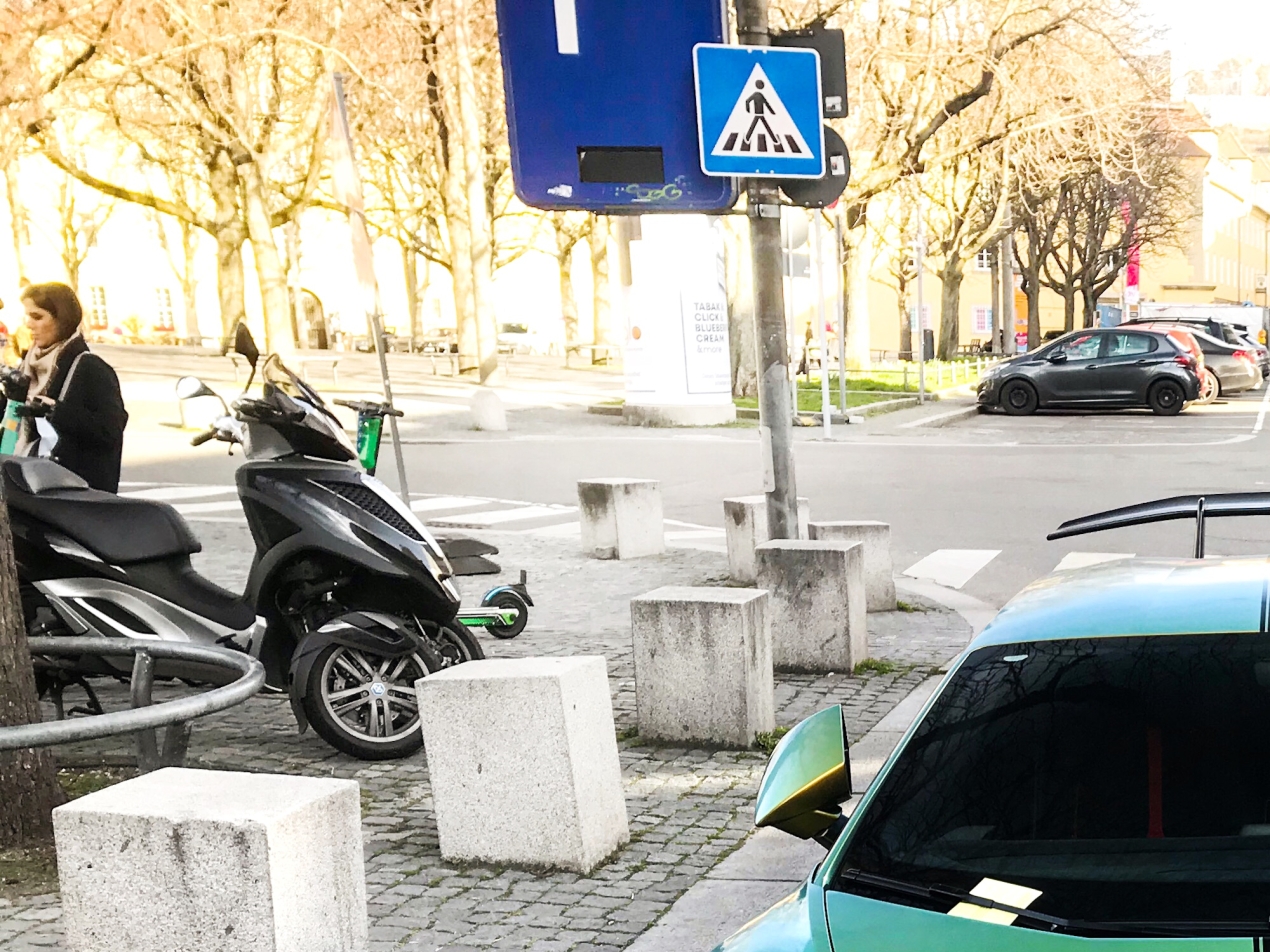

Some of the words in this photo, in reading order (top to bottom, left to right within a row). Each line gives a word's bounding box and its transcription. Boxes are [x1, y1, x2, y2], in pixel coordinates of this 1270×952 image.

[694, 302, 720, 311] TABAK
[694, 313, 719, 322] CLICK
[696, 334, 725, 343] CREAM
